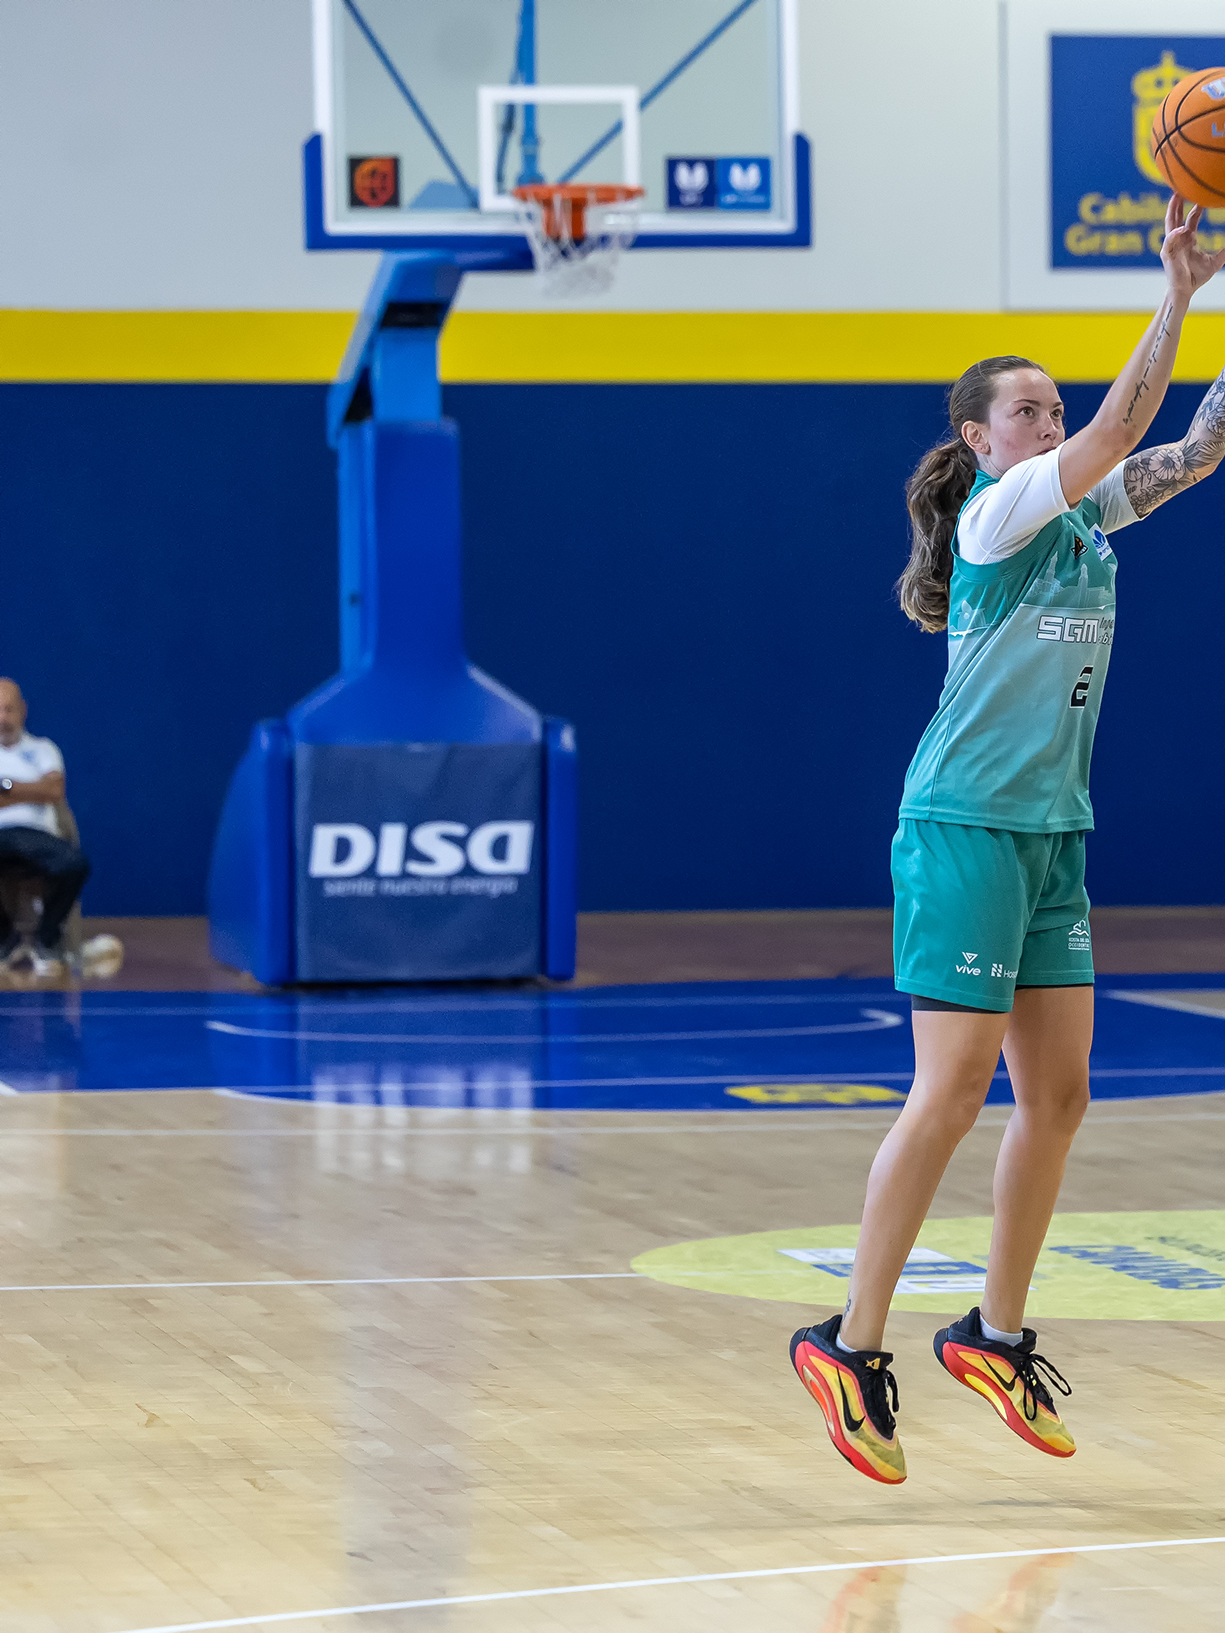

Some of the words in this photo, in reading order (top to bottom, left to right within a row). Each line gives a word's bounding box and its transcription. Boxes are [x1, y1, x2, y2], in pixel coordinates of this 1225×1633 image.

[1037, 615, 1099, 644] SGM
[1069, 664, 1094, 709] 2
[955, 964, 982, 976] vive
